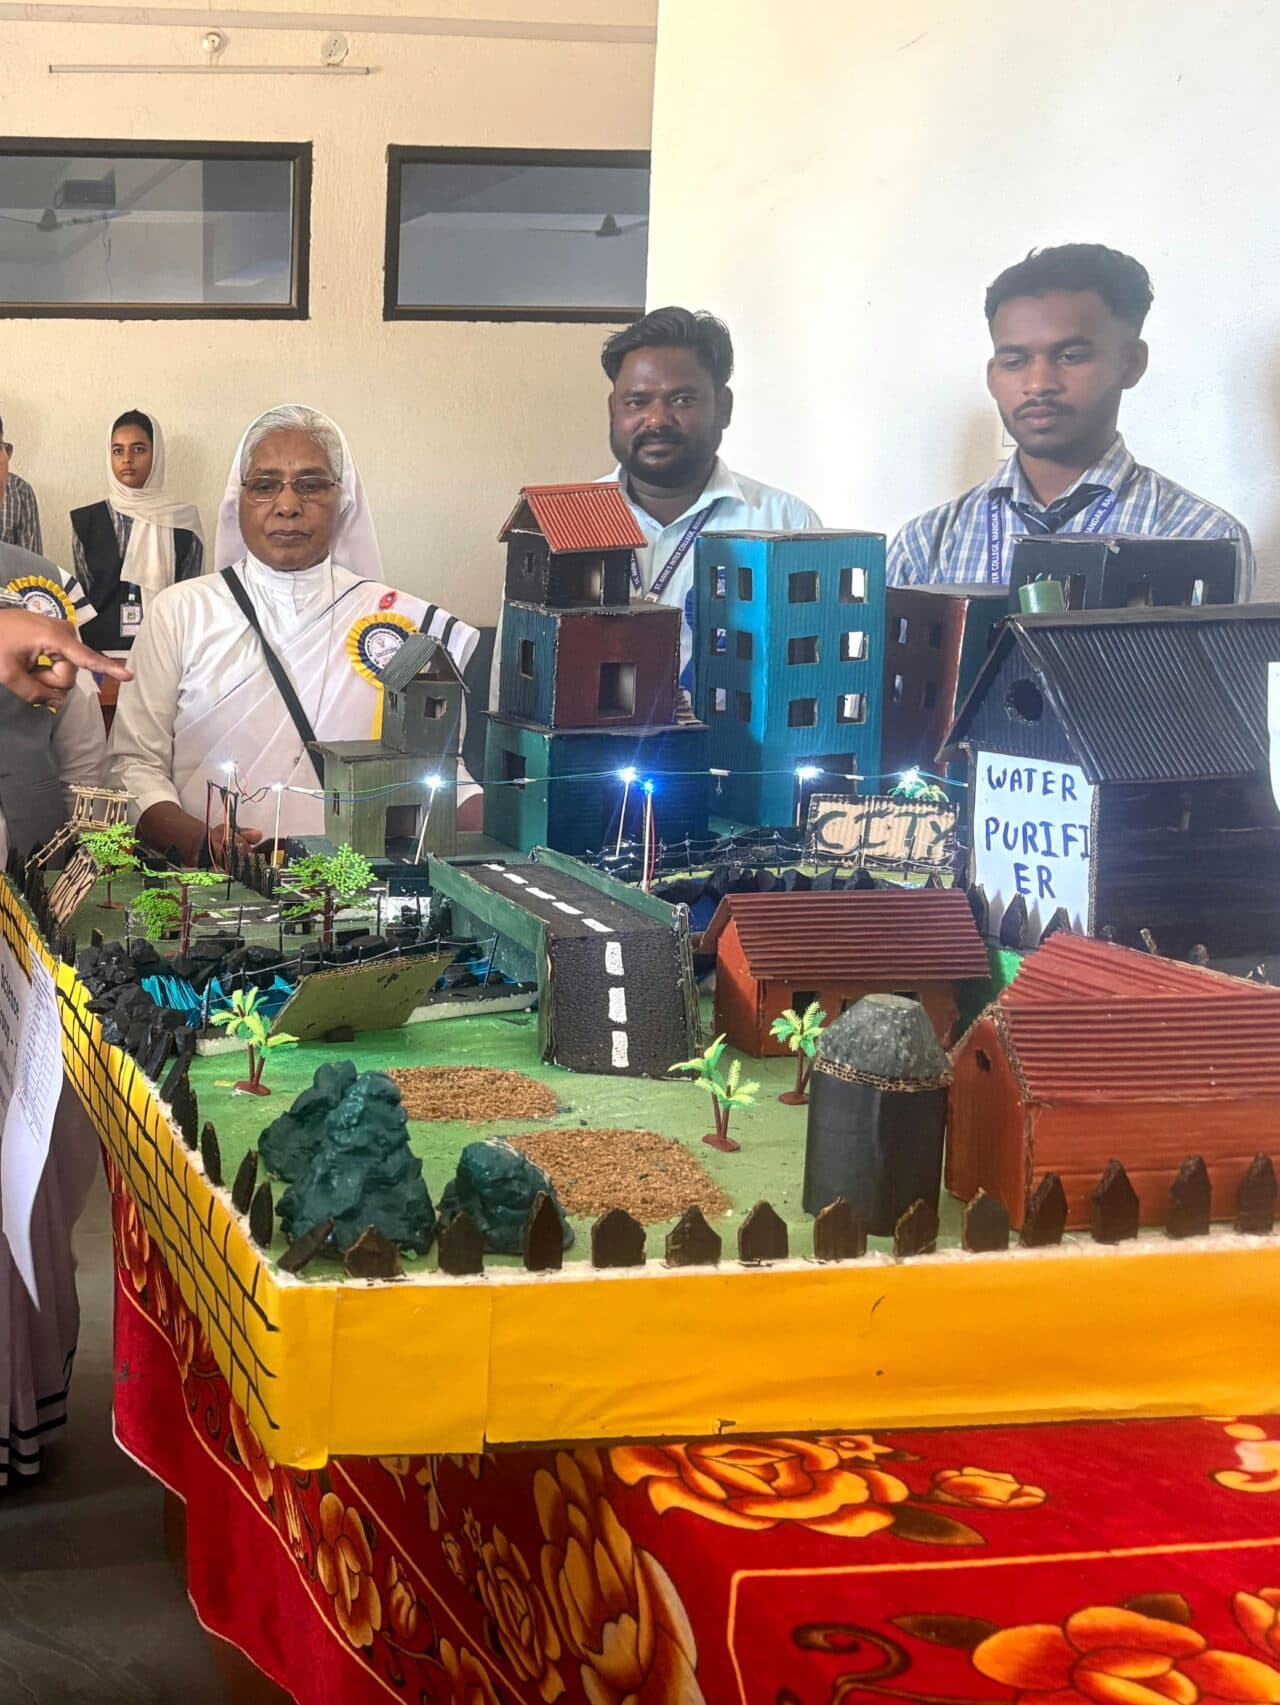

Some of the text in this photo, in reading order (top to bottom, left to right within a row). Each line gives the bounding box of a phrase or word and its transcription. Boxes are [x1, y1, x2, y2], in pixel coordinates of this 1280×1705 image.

[986, 764, 1078, 802] WATER
[984, 816, 1090, 860] PURIFI
[46, 853, 94, 913] PARK
[1013, 862, 1057, 900] ER
